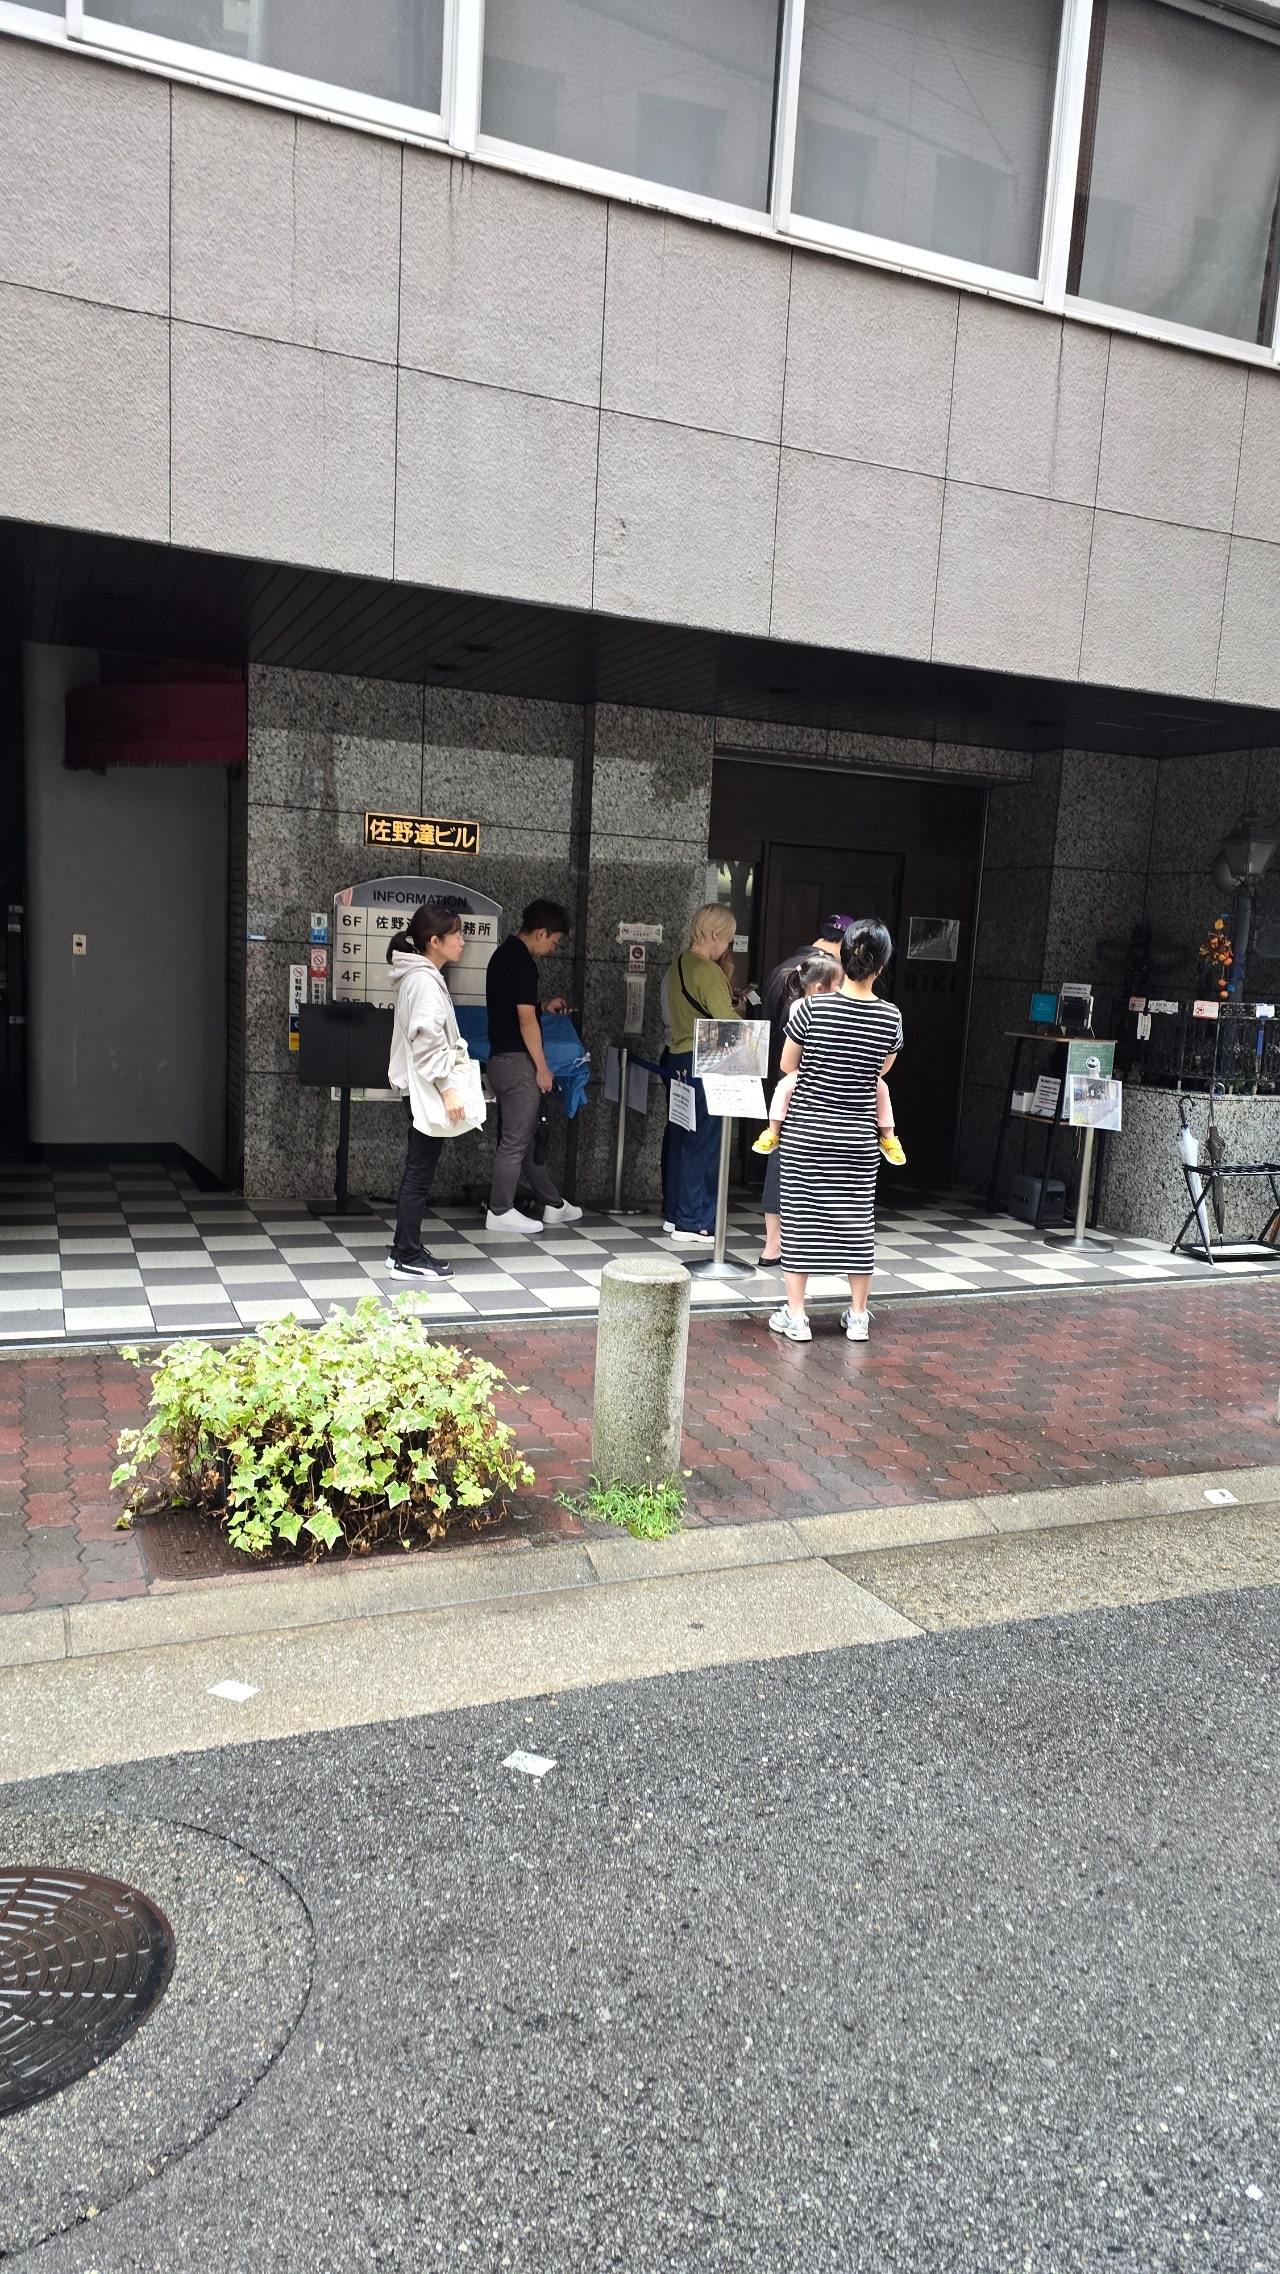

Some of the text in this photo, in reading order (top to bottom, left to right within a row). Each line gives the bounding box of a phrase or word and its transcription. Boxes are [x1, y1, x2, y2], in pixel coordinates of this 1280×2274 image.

[369, 818, 476, 848] 佐野達ビル
[373, 890, 468, 908] INFORMATION
[342, 914, 362, 928] 6F
[341, 942, 362, 955] 5F
[341, 970, 362, 983] 4F
[904, 973, 957, 995] RIKI
